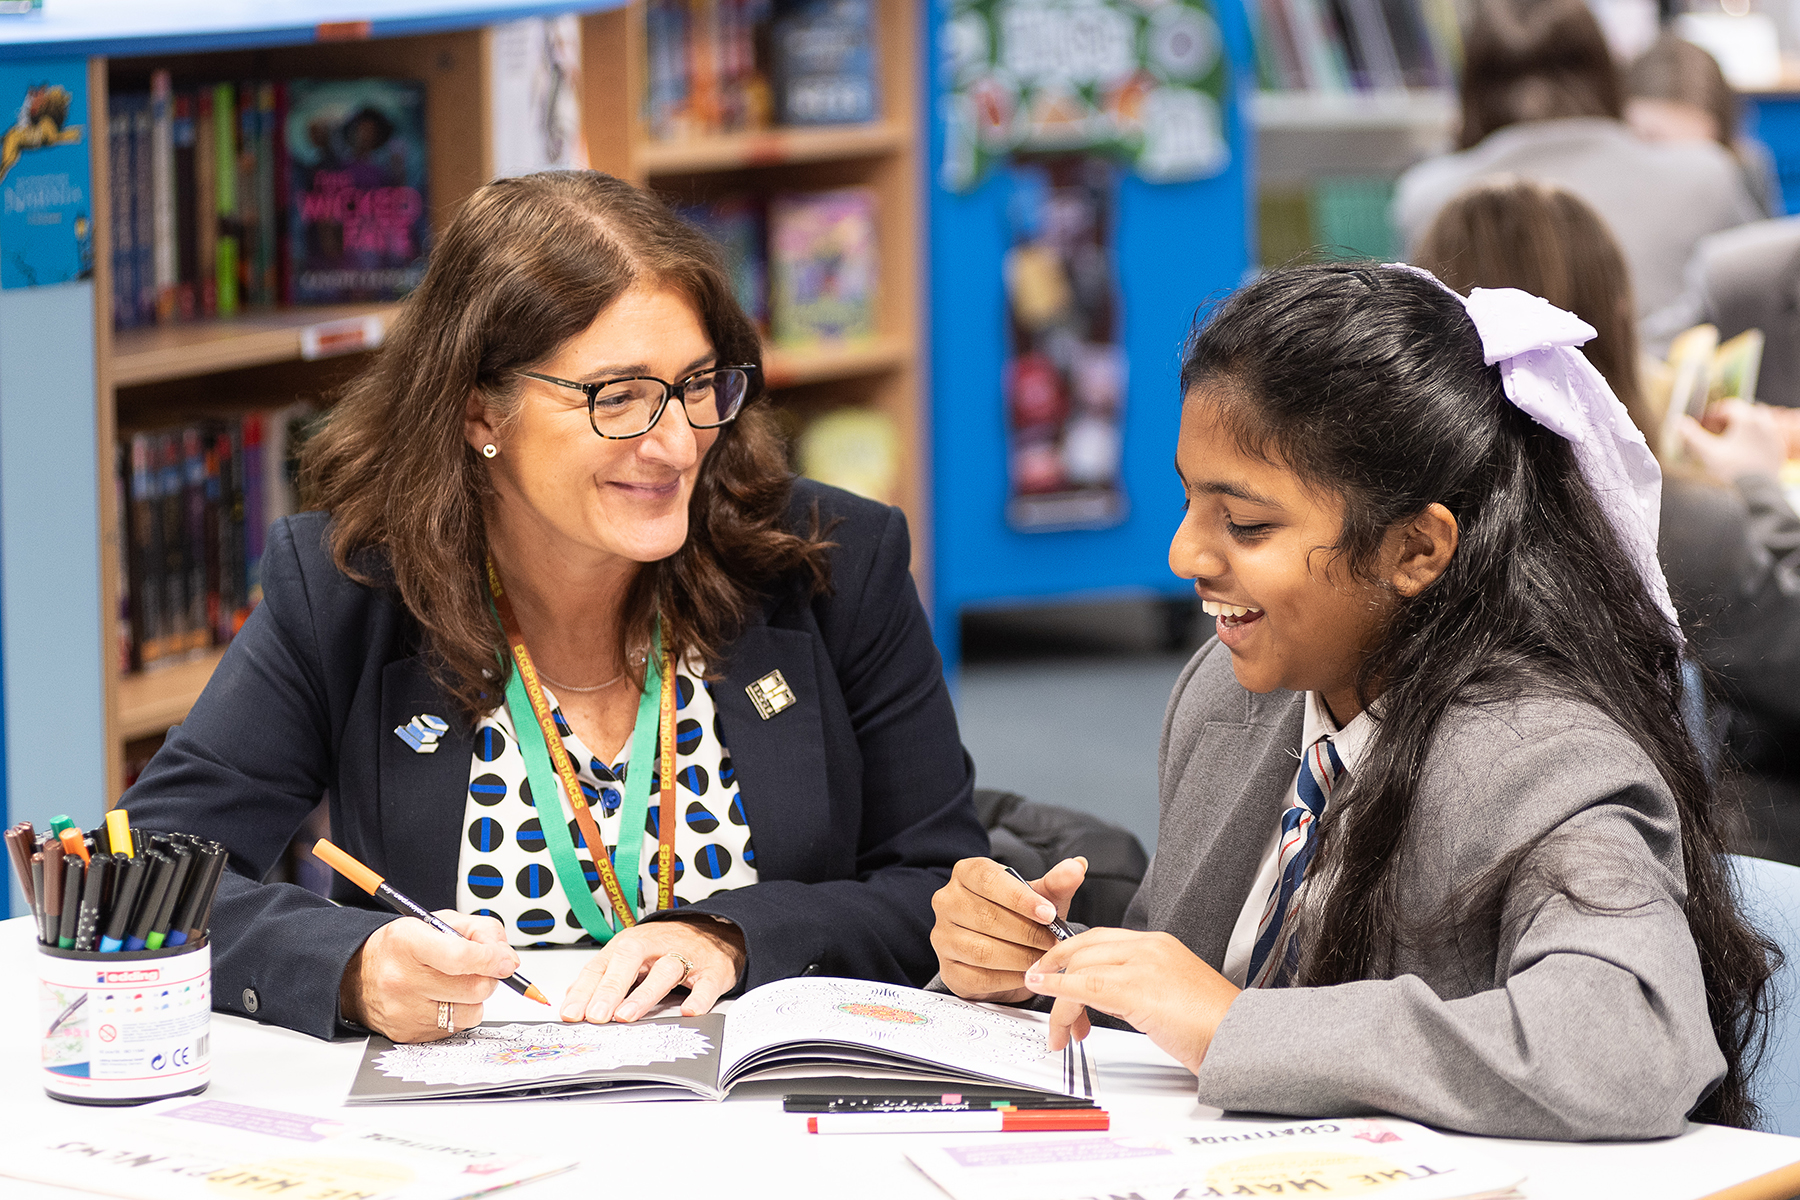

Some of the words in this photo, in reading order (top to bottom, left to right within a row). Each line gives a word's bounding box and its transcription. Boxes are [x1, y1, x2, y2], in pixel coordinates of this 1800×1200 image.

[514, 644, 548, 719] EXCEPTIONAL
[542, 717, 585, 810] CIRCUMSTANCES
[660, 712, 672, 790] EXCEPTIONAL
[597, 857, 634, 928] EXCEPTIONA
[107, 970, 158, 982] edding
[359, 1132, 497, 1158] GRATITUDE
[1185, 1124, 1341, 1145] GRATITUDE
[46, 1141, 171, 1168] NEWS
[1347, 1164, 1456, 1187] THE
